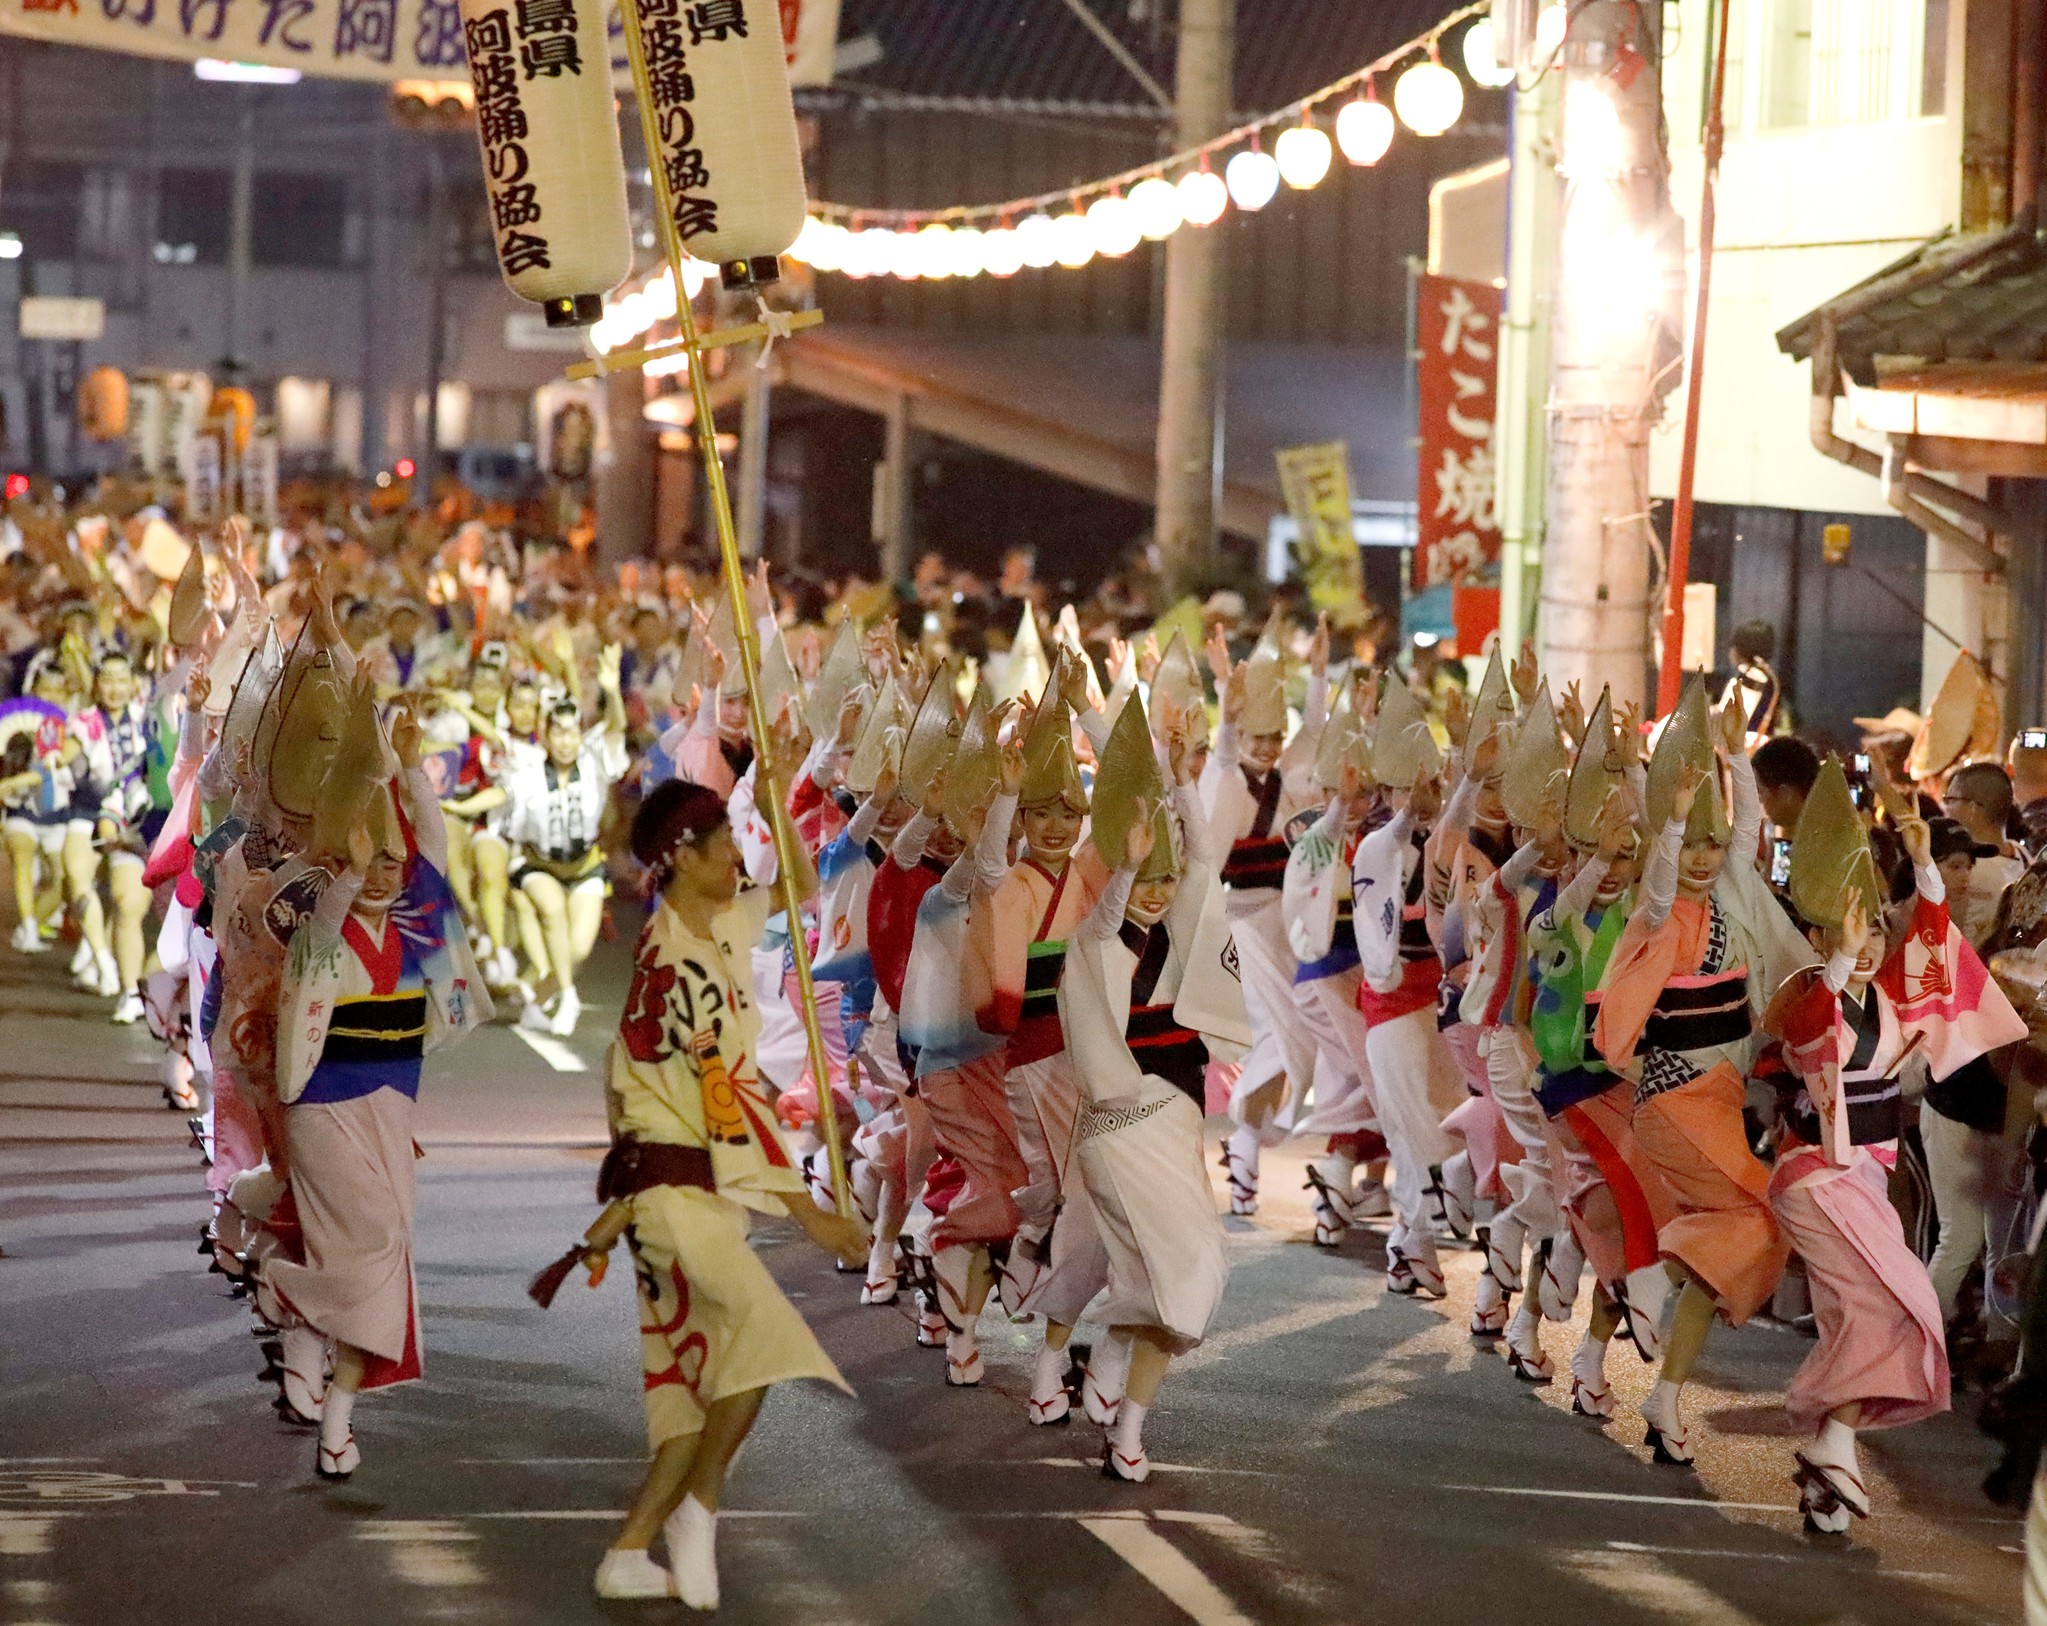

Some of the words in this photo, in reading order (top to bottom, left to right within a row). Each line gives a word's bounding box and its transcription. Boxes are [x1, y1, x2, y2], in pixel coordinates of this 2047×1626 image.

[465, 8, 551, 276] 阿波踊り協会
